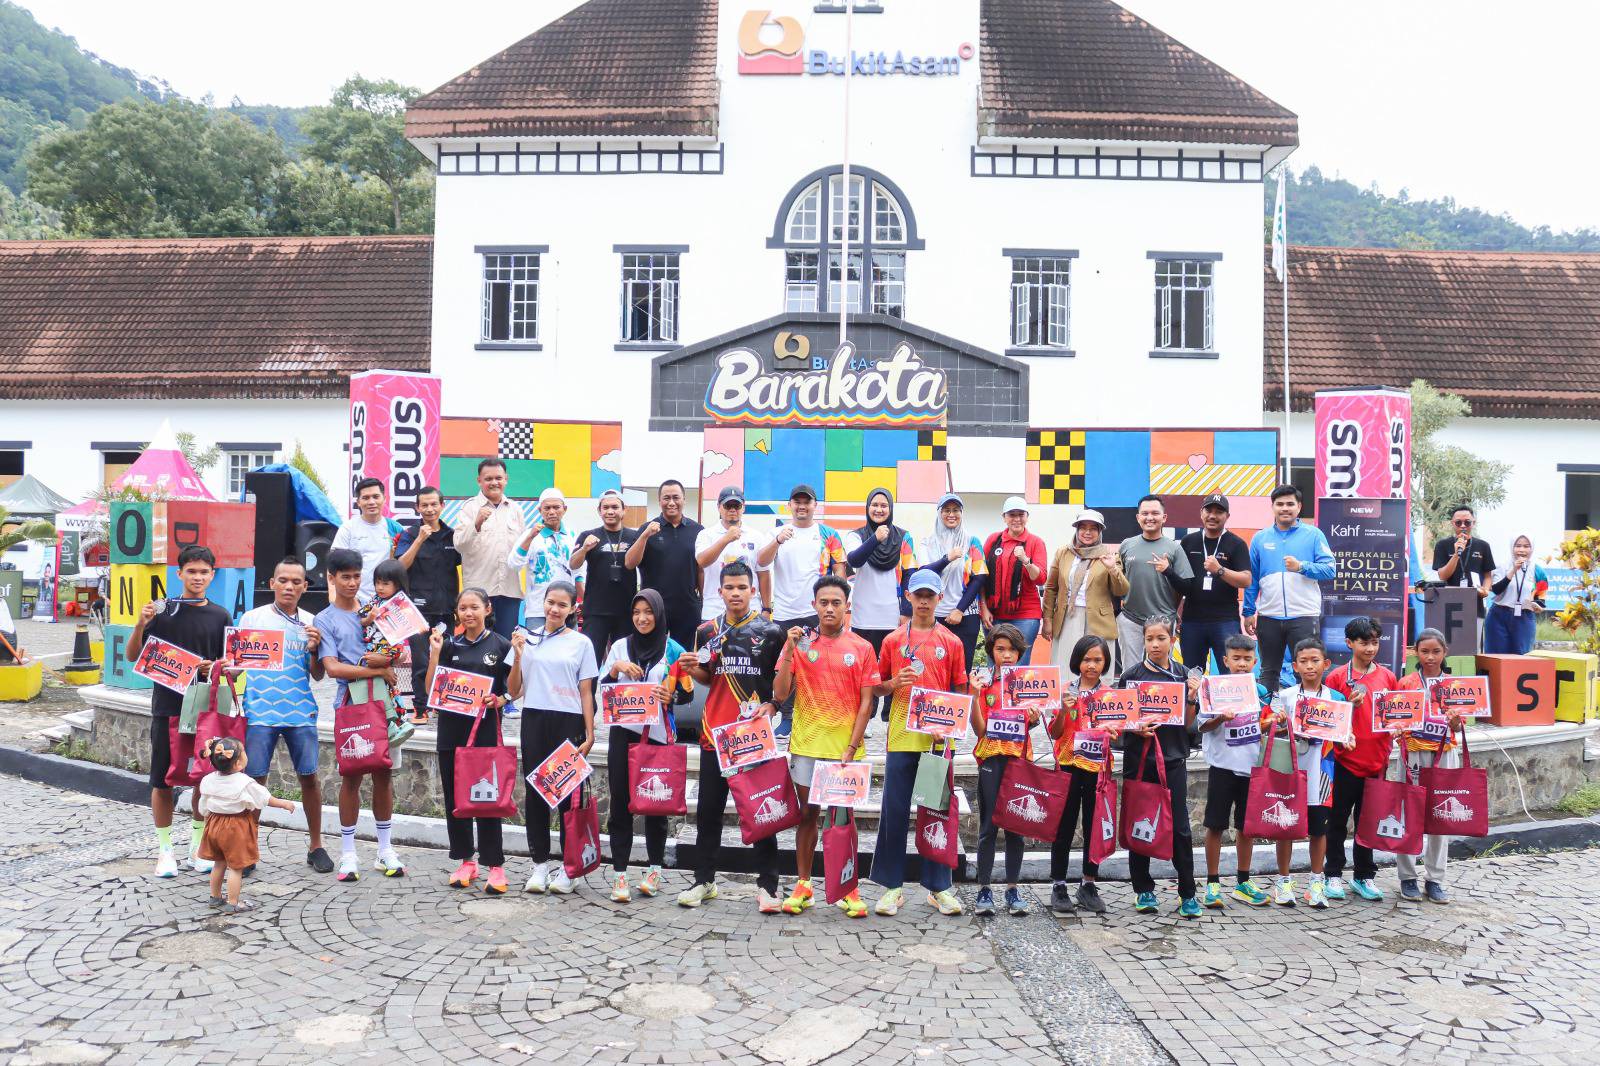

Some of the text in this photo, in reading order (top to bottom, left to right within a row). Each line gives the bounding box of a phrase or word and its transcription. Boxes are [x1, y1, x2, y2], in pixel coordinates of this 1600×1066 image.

[711, 341, 947, 410] Barakota
[395, 400, 422, 526] smar
[1330, 423, 1358, 497] sm
[1391, 421, 1404, 497] sm
[116, 509, 147, 556] O
[1331, 524, 1360, 537] Kahf
[62, 535, 75, 567] Kahf
[1332, 551, 1399, 559] NBREAKABLE
[1335, 558, 1395, 571] HOLD
[1337, 572, 1399, 580] BREAKABLE
[1333, 580, 1389, 592] HAIR
[119, 576, 134, 616] N
[233, 579, 246, 620] A
[1444, 602, 1464, 645] F
[231, 640, 279, 652] JUARA 2
[112, 635, 124, 677] E
[148, 648, 183, 671] JUARA
[185, 666, 193, 675] 3
[738, 656, 751, 666] XXI
[747, 666, 761, 675] 2024
[439, 682, 484, 698] JUARA 1
[1008, 679, 1056, 690] JUARA 1
[1438, 687, 1482, 697] JUARA 1
[1516, 672, 1540, 712] S
[608, 696, 655, 707] JUARA 3
[1086, 701, 1124, 712] JUARA
[1127, 701, 1134, 710] 2
[1137, 694, 1178, 705] UARA 3
[1378, 700, 1420, 711] JUARA 2
[915, 701, 964, 718] JUARA 2
[1300, 704, 1345, 722] JUARA 2
[993, 721, 1020, 733] 0149
[1238, 725, 1258, 737] 026
[722, 733, 759, 750] JUARA
[760, 729, 768, 739] 3
[542, 760, 572, 788] JUARA
[860, 777, 864, 787] 1
